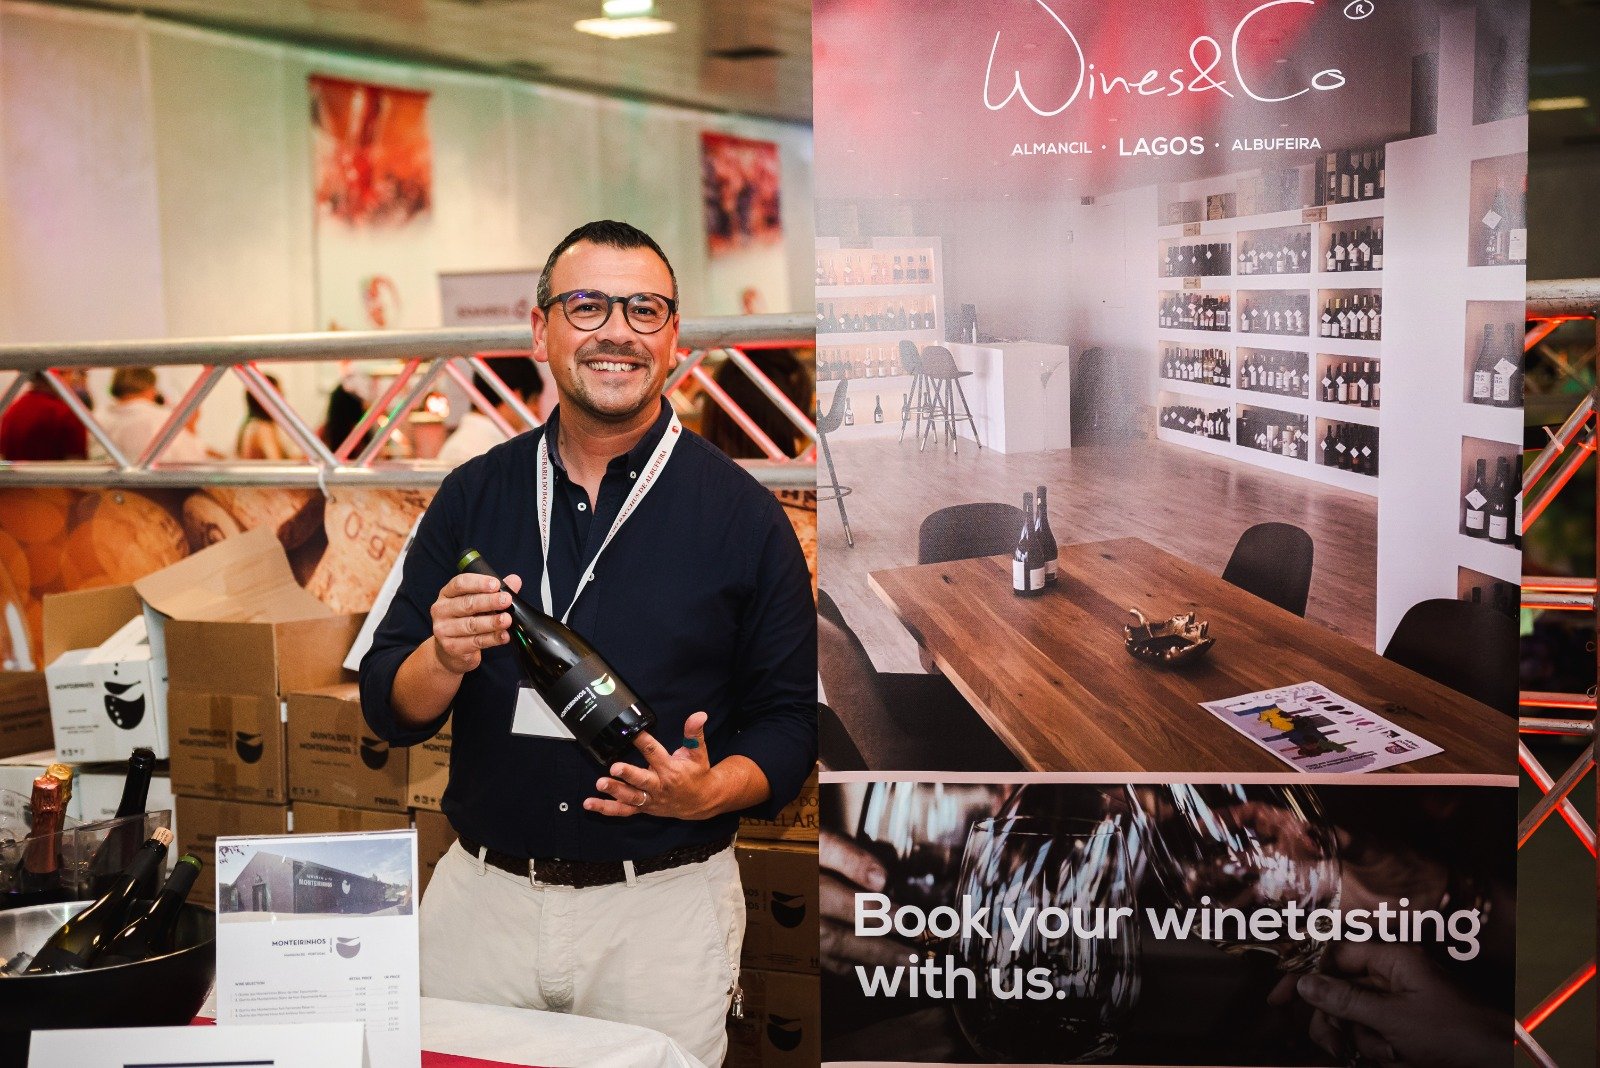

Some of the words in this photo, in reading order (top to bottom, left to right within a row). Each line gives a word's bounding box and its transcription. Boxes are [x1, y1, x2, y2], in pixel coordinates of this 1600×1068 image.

[1011, 141, 1093, 157] ALMANCIL
[1119, 136, 1206, 157] LAGOS
[1231, 136, 1322, 153] ALBUFEIRA
[638, 481, 649, 495] DE
[644, 449, 669, 484] ALBUFEIRA
[271, 938, 327, 947] MONTEIRINHOS
[853, 891, 994, 939] Book
[1003, 904, 1134, 952] your
[1145, 895, 1482, 962] winetasting
[854, 954, 977, 1000] with
[990, 965, 1067, 1001] us.
